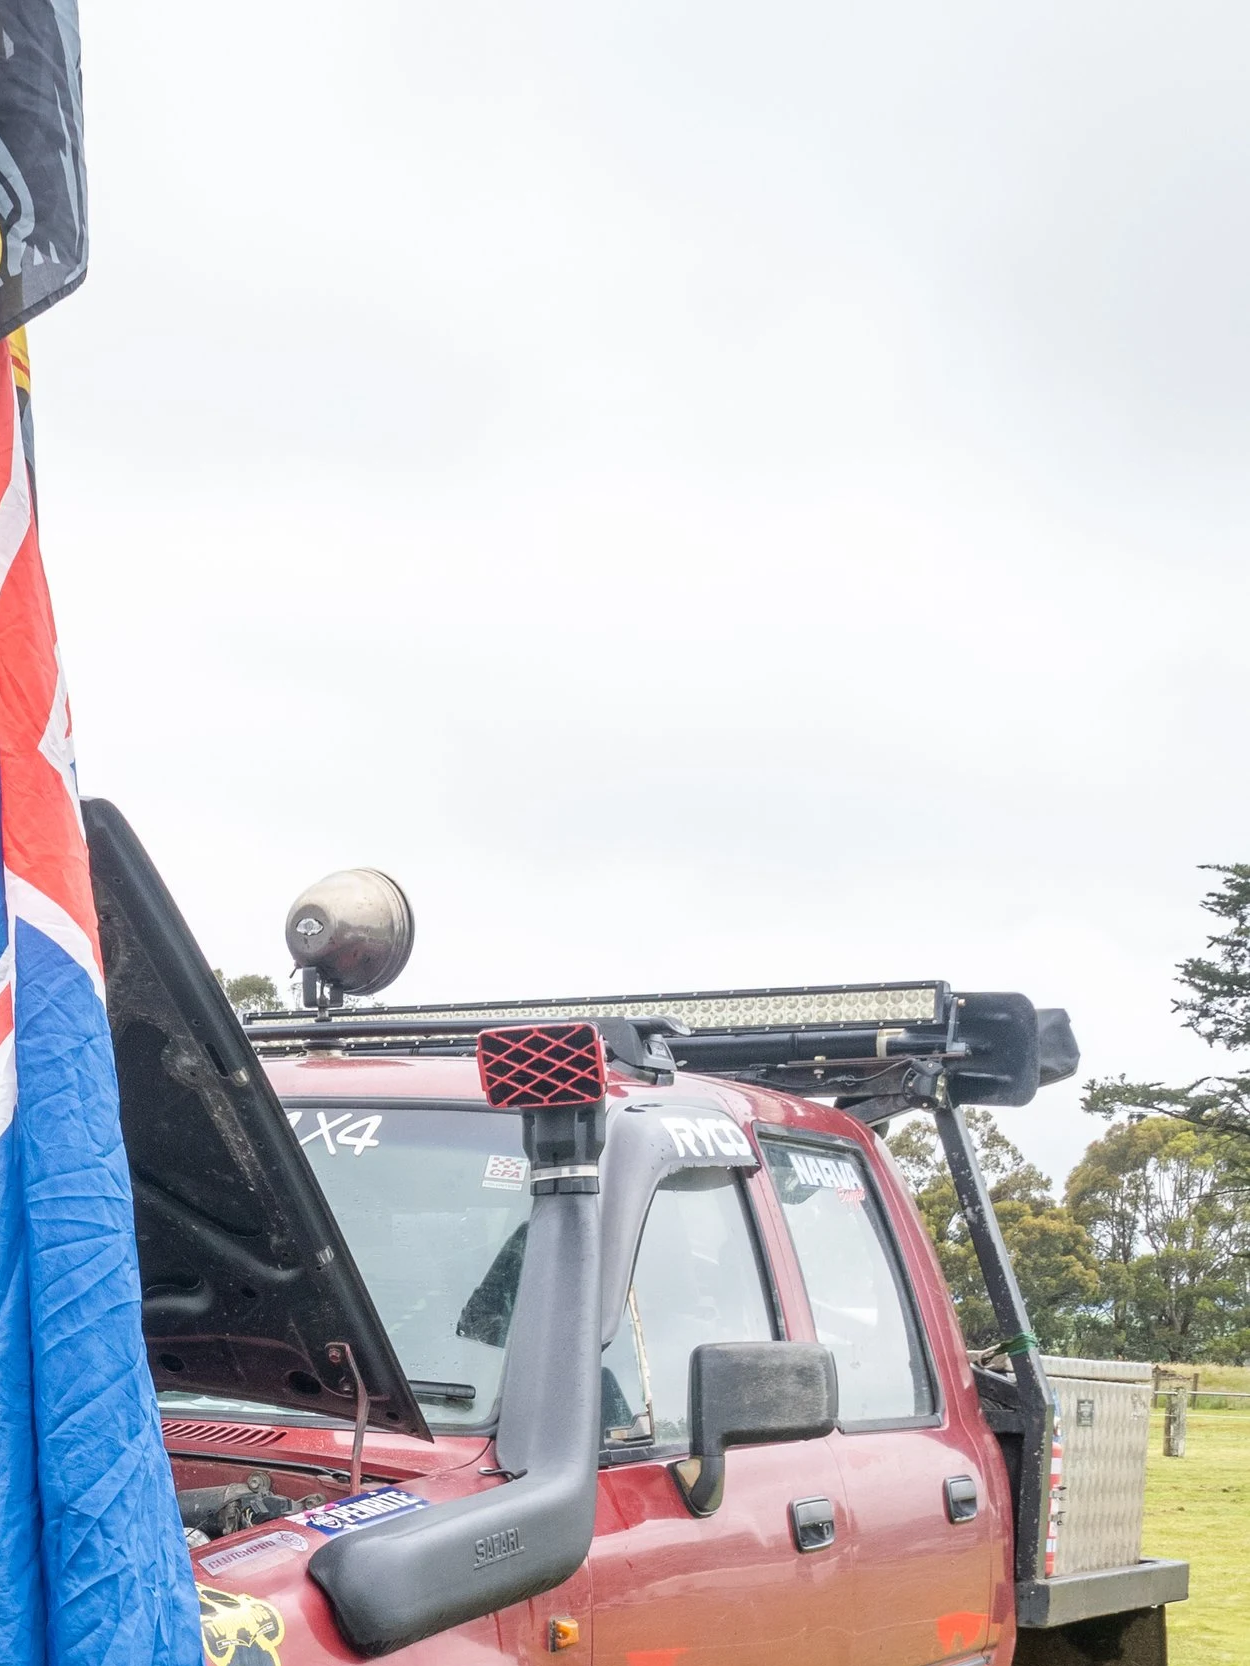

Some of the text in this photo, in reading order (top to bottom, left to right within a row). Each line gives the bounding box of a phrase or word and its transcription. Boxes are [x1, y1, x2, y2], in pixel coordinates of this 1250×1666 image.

[287, 1111, 383, 1156] X4
[660, 1117, 751, 1158] RYCO
[490, 1169, 519, 1178] CFA
[787, 1152, 864, 1190] NARVA
[326, 1491, 422, 1524] PENRITE
[207, 1539, 277, 1570] CLUTCHPRO
[475, 1527, 519, 1562] SAFARI
